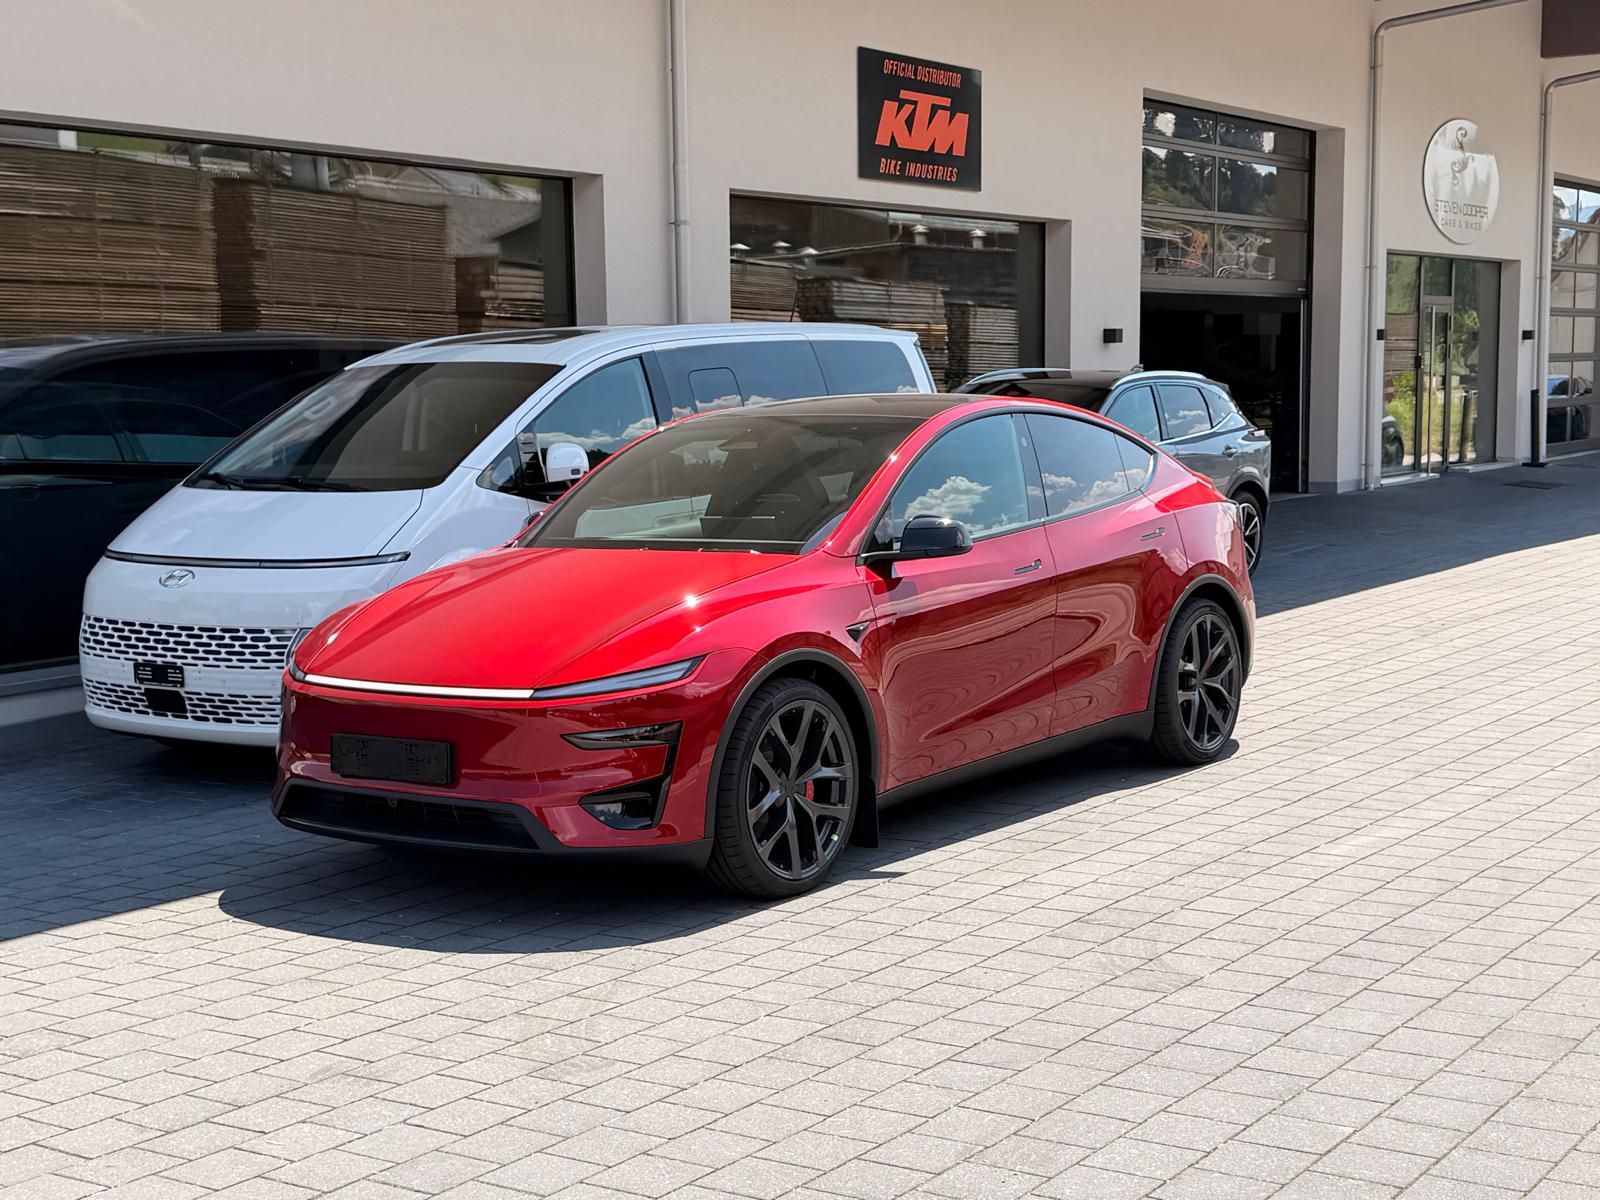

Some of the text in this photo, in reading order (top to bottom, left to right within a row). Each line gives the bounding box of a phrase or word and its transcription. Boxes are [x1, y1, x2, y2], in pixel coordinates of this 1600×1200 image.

[883, 59, 962, 88] OFFICIAL DISTRIBUTOR
[875, 89, 969, 157] KTM
[880, 158, 958, 182] BIKE INDUSTRIES
